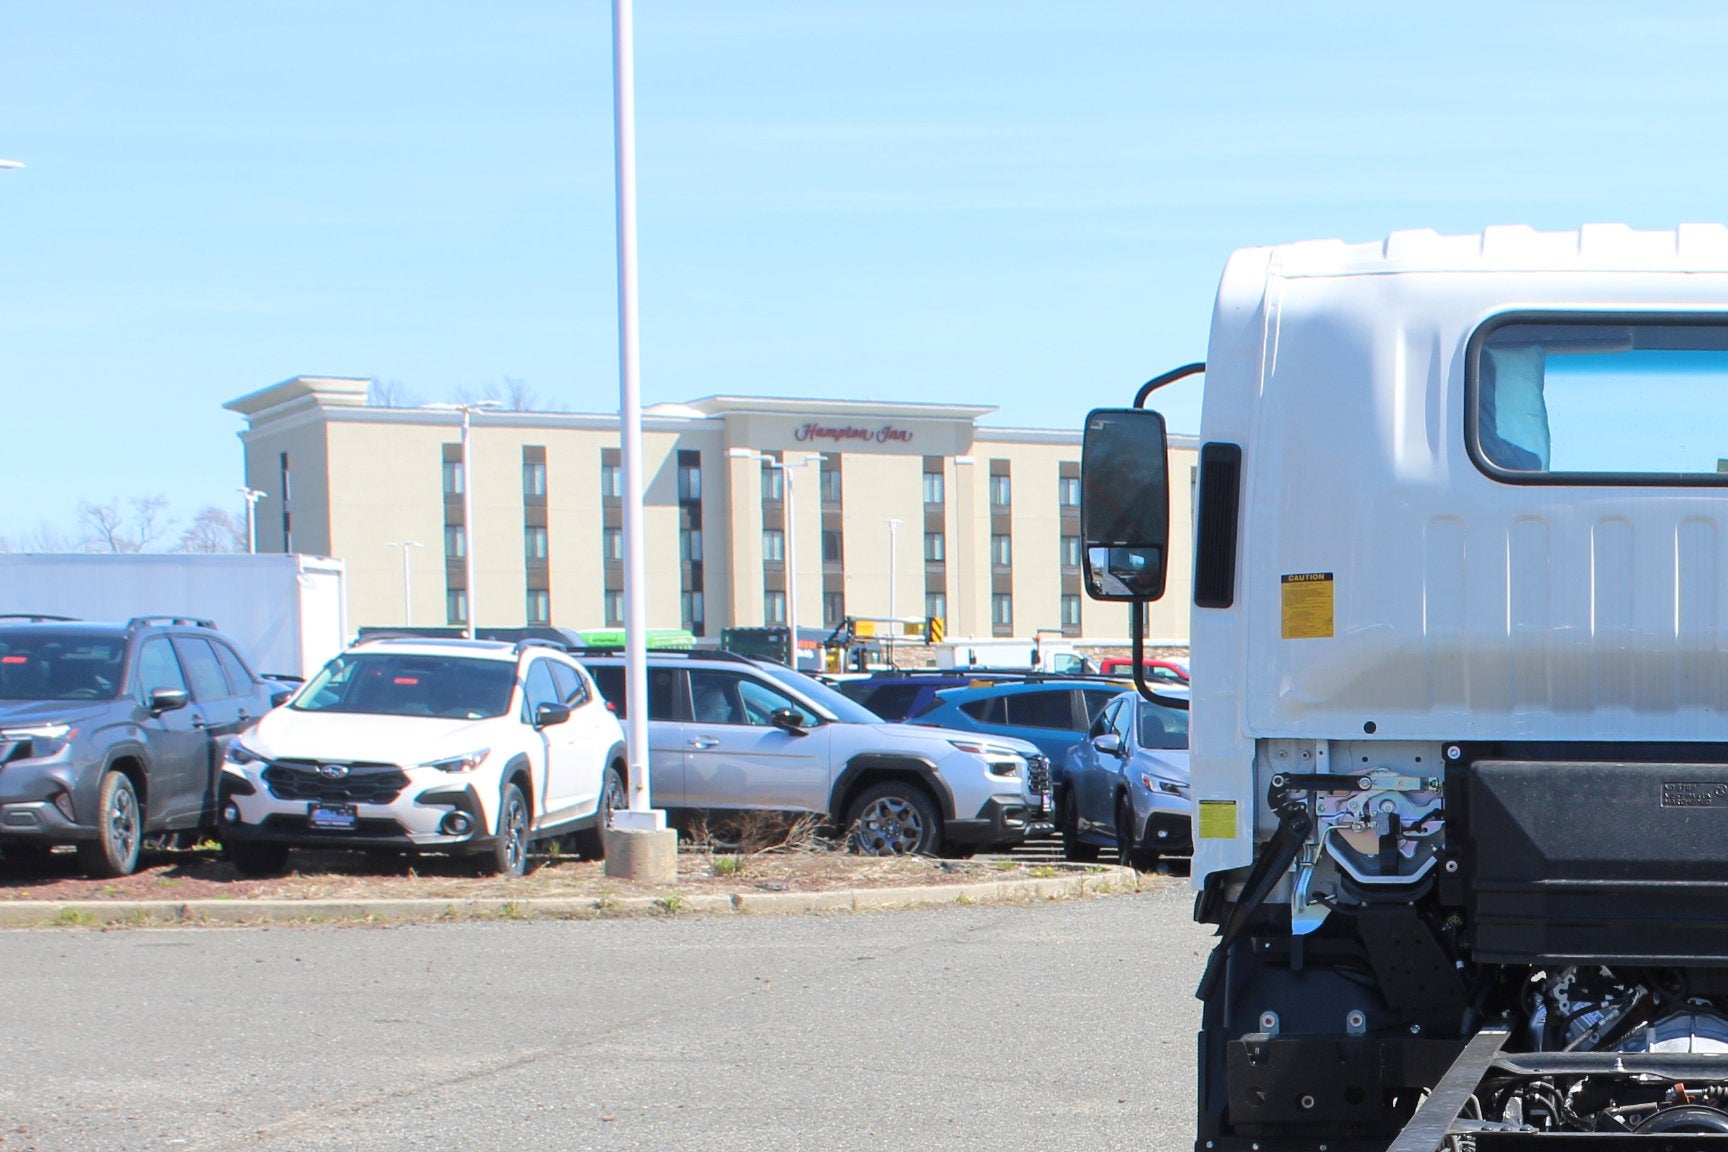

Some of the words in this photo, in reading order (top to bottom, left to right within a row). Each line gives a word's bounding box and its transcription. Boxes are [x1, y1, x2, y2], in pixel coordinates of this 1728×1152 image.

[794, 423, 875, 442] Hampton
[876, 425, 914, 443] Inn
[1288, 573, 1325, 582] CAUTION
